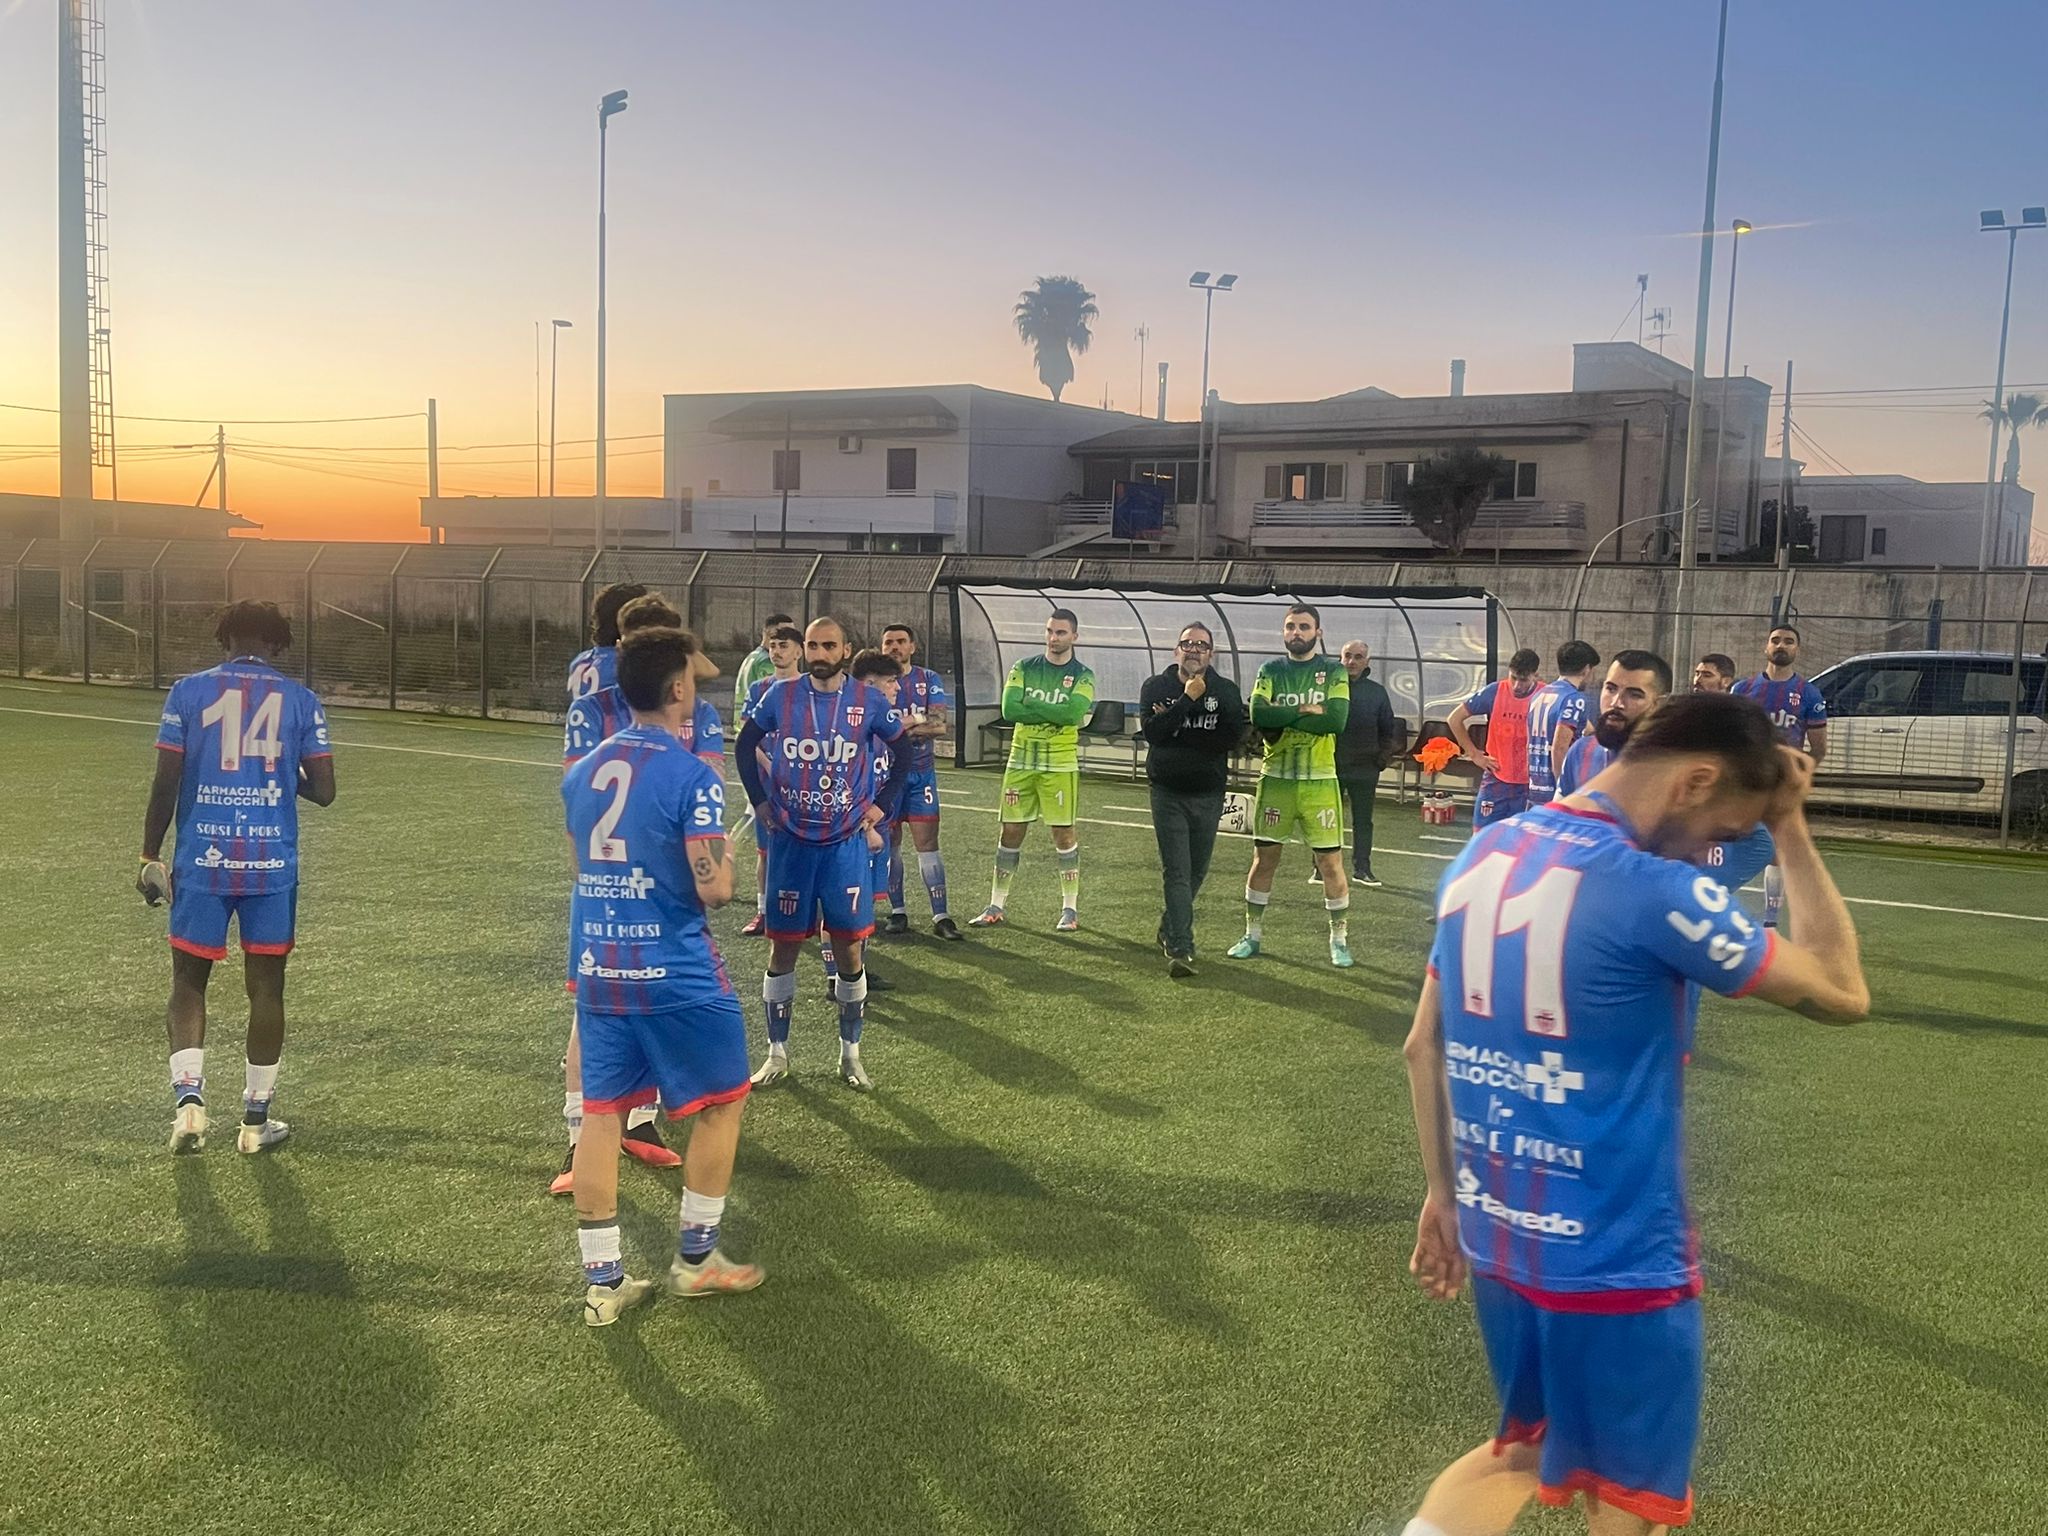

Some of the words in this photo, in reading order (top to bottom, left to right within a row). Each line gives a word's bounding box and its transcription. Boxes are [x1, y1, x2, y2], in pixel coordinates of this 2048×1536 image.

[1530, 692, 1559, 737] 17
[202, 688, 283, 773] 14
[789, 762, 848, 772] NOLEGGI
[196, 794, 266, 806] BELLOCCHI
[197, 784, 260, 797] FARMACIA
[924, 786, 934, 804] 5
[1055, 790, 1063, 806] 1
[590, 760, 632, 861] 2
[1316, 808, 1336, 830] 12
[196, 822, 231, 836] SORSI
[248, 826, 281, 837] MORS
[1706, 845, 1723, 867] 18
[847, 886, 861, 914] 7
[617, 923, 661, 938] MORSI
[1439, 851, 1584, 1038] 11
